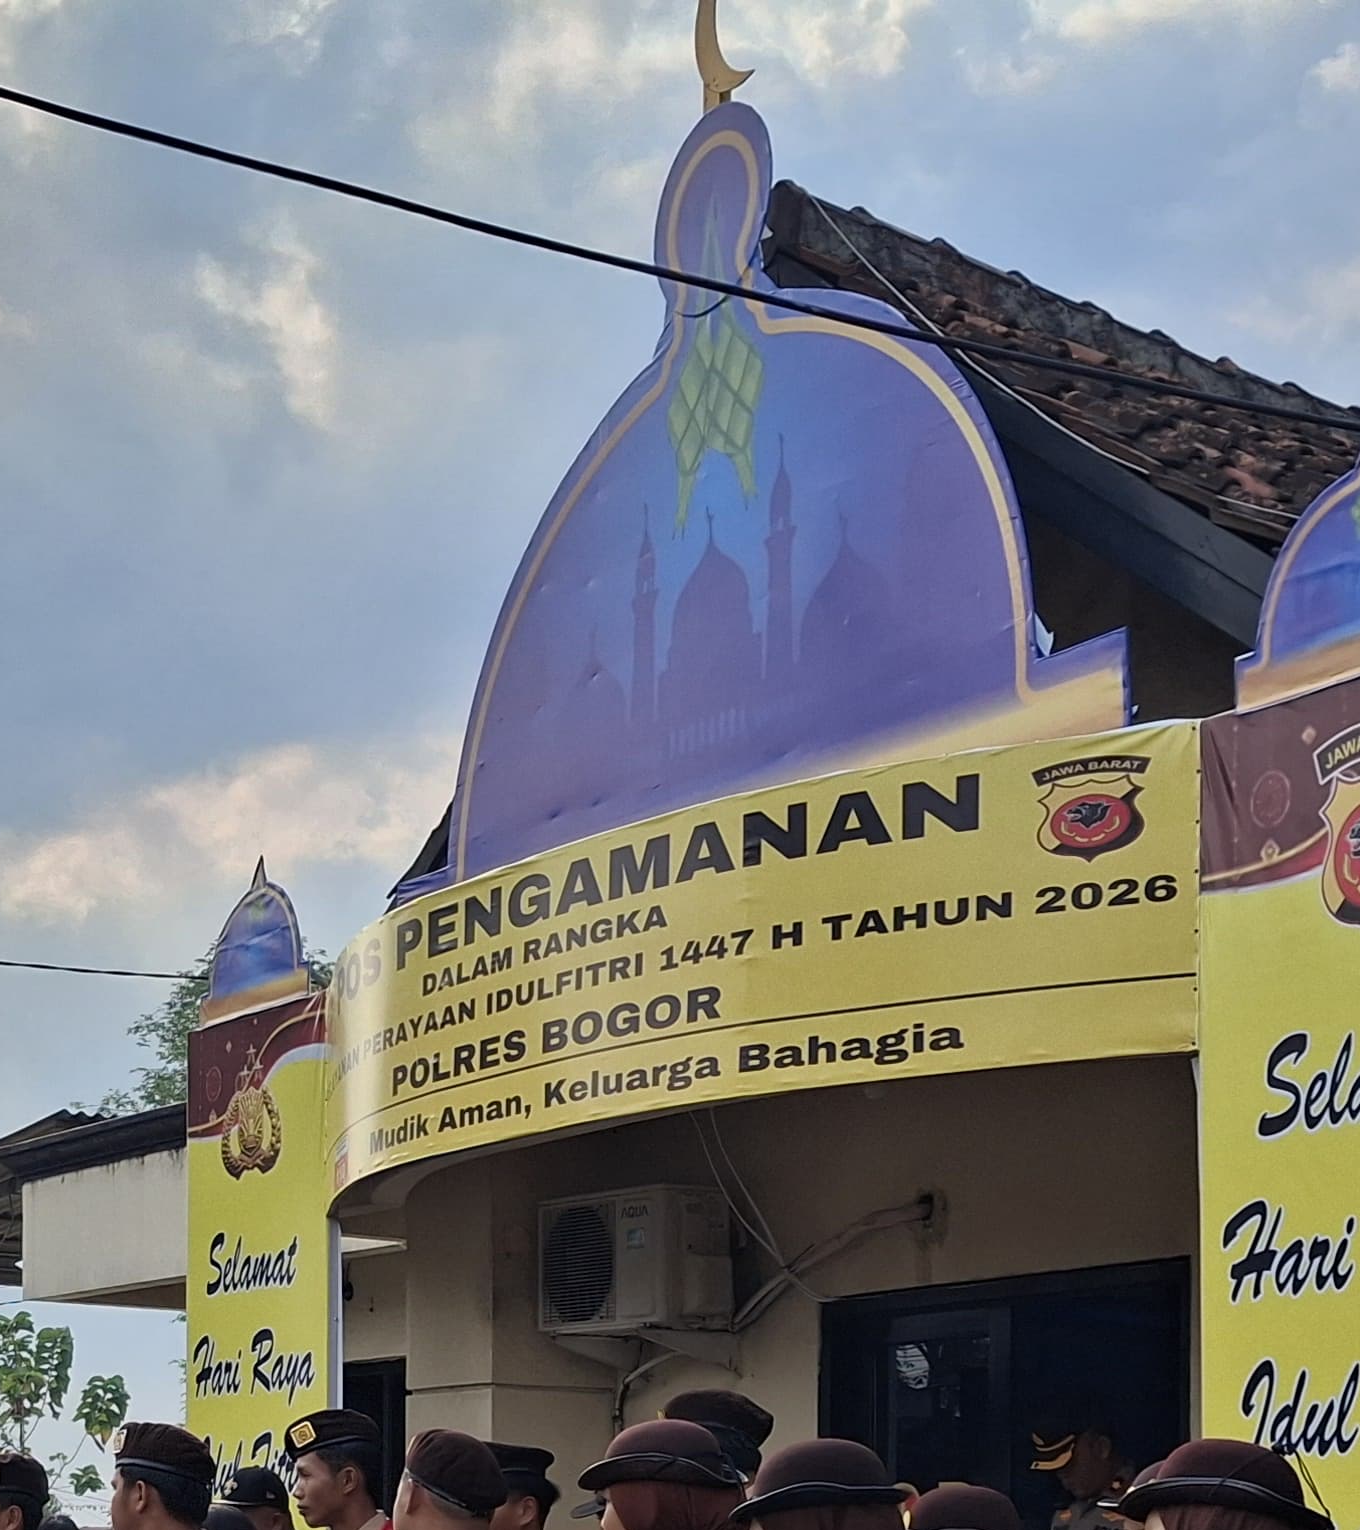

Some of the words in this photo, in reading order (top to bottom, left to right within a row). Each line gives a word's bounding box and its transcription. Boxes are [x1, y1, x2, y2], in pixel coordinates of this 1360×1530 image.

[1042, 764, 1085, 781] JAWA
[1088, 759, 1142, 771] BARAT
[396, 774, 980, 971] PENGAMANAN
[363, 999, 476, 1059] PERAYAAN
[486, 953, 644, 1016] IDULFITRI
[659, 929, 755, 972] 1447
[771, 922, 803, 950] H
[822, 892, 1013, 942] TAHUN
[1035, 875, 1178, 915] 2026
[422, 947, 513, 997] DALAM
[523, 905, 668, 964] RANGKA
[369, 1114, 429, 1155] Mudik
[437, 1094, 532, 1133] Aman,
[544, 1055, 721, 1109] Keluarga
[738, 1022, 965, 1074] Bahagia
[391, 1030, 526, 1097] POLRES
[542, 986, 722, 1055] BOGOR
[620, 1205, 649, 1219] AQUA
[1223, 1200, 1355, 1302] Hari
[206, 1232, 298, 1296] Selamat
[193, 1335, 242, 1398] Hari
[250, 1328, 315, 1407] Raya
[1242, 1359, 1360, 1457] Idul
